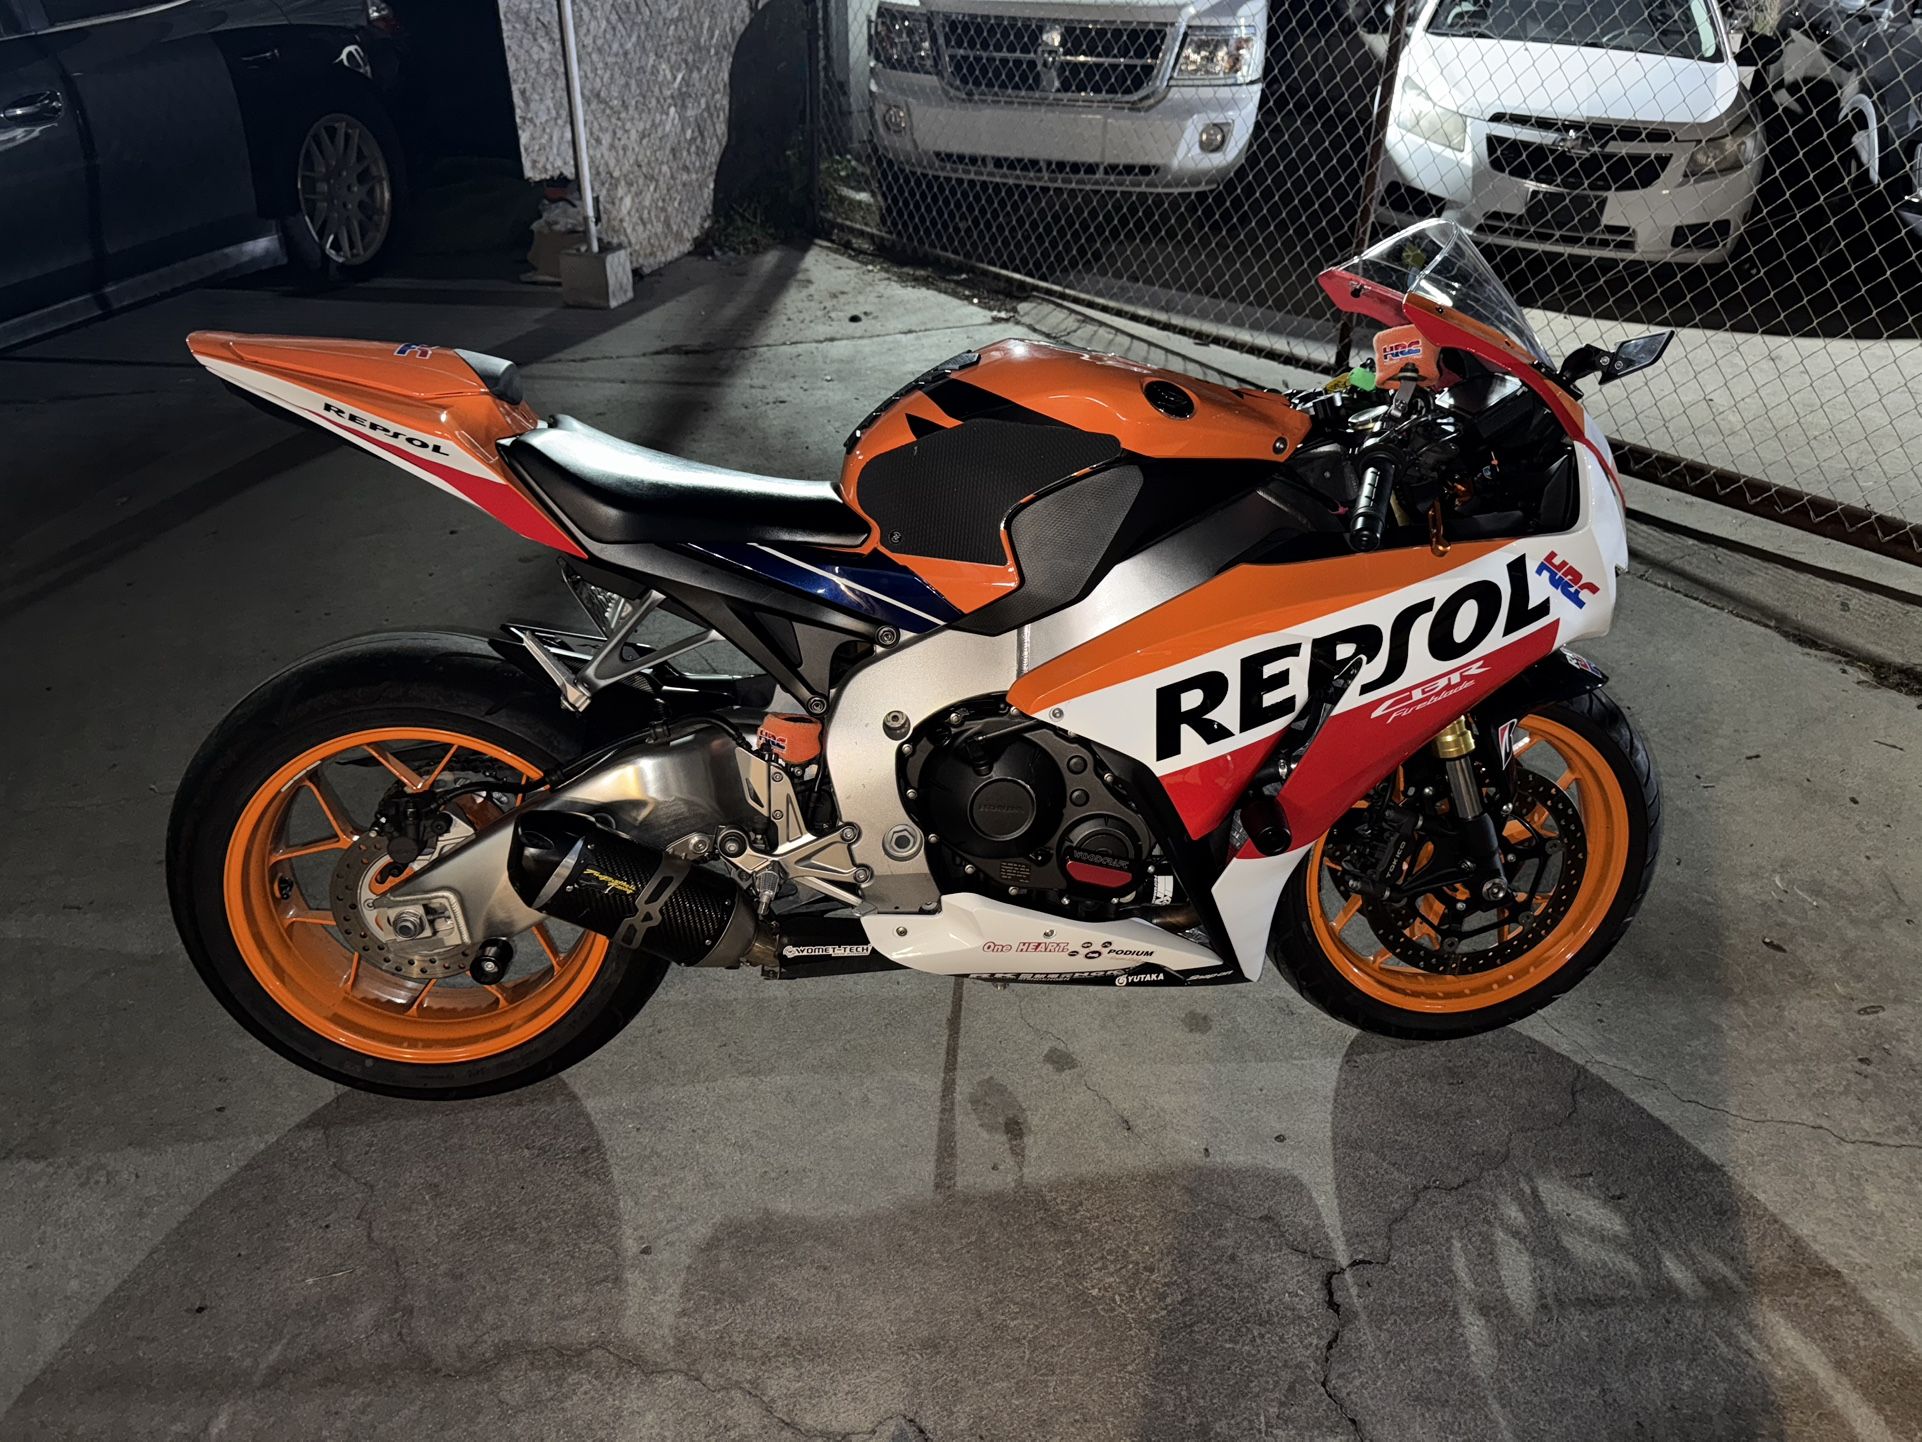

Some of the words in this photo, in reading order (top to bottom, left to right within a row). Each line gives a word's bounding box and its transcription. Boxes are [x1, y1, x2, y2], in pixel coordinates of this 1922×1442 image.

[1382, 340, 1422, 361] HRC
[323, 402, 450, 457] REPSOL
[1535, 550, 1600, 609] HRC
[1155, 553, 1551, 762] REPSOL
[1370, 660, 1492, 719] CBR
[1386, 679, 1476, 724] Fireblade
[1385, 841, 1406, 879] TOKICO
[794, 945, 869, 955] WOMET-TECH
[982, 941, 1012, 952] One
[1107, 949, 1155, 957] PODIUM
[1128, 972, 1165, 982] YUTAKA
